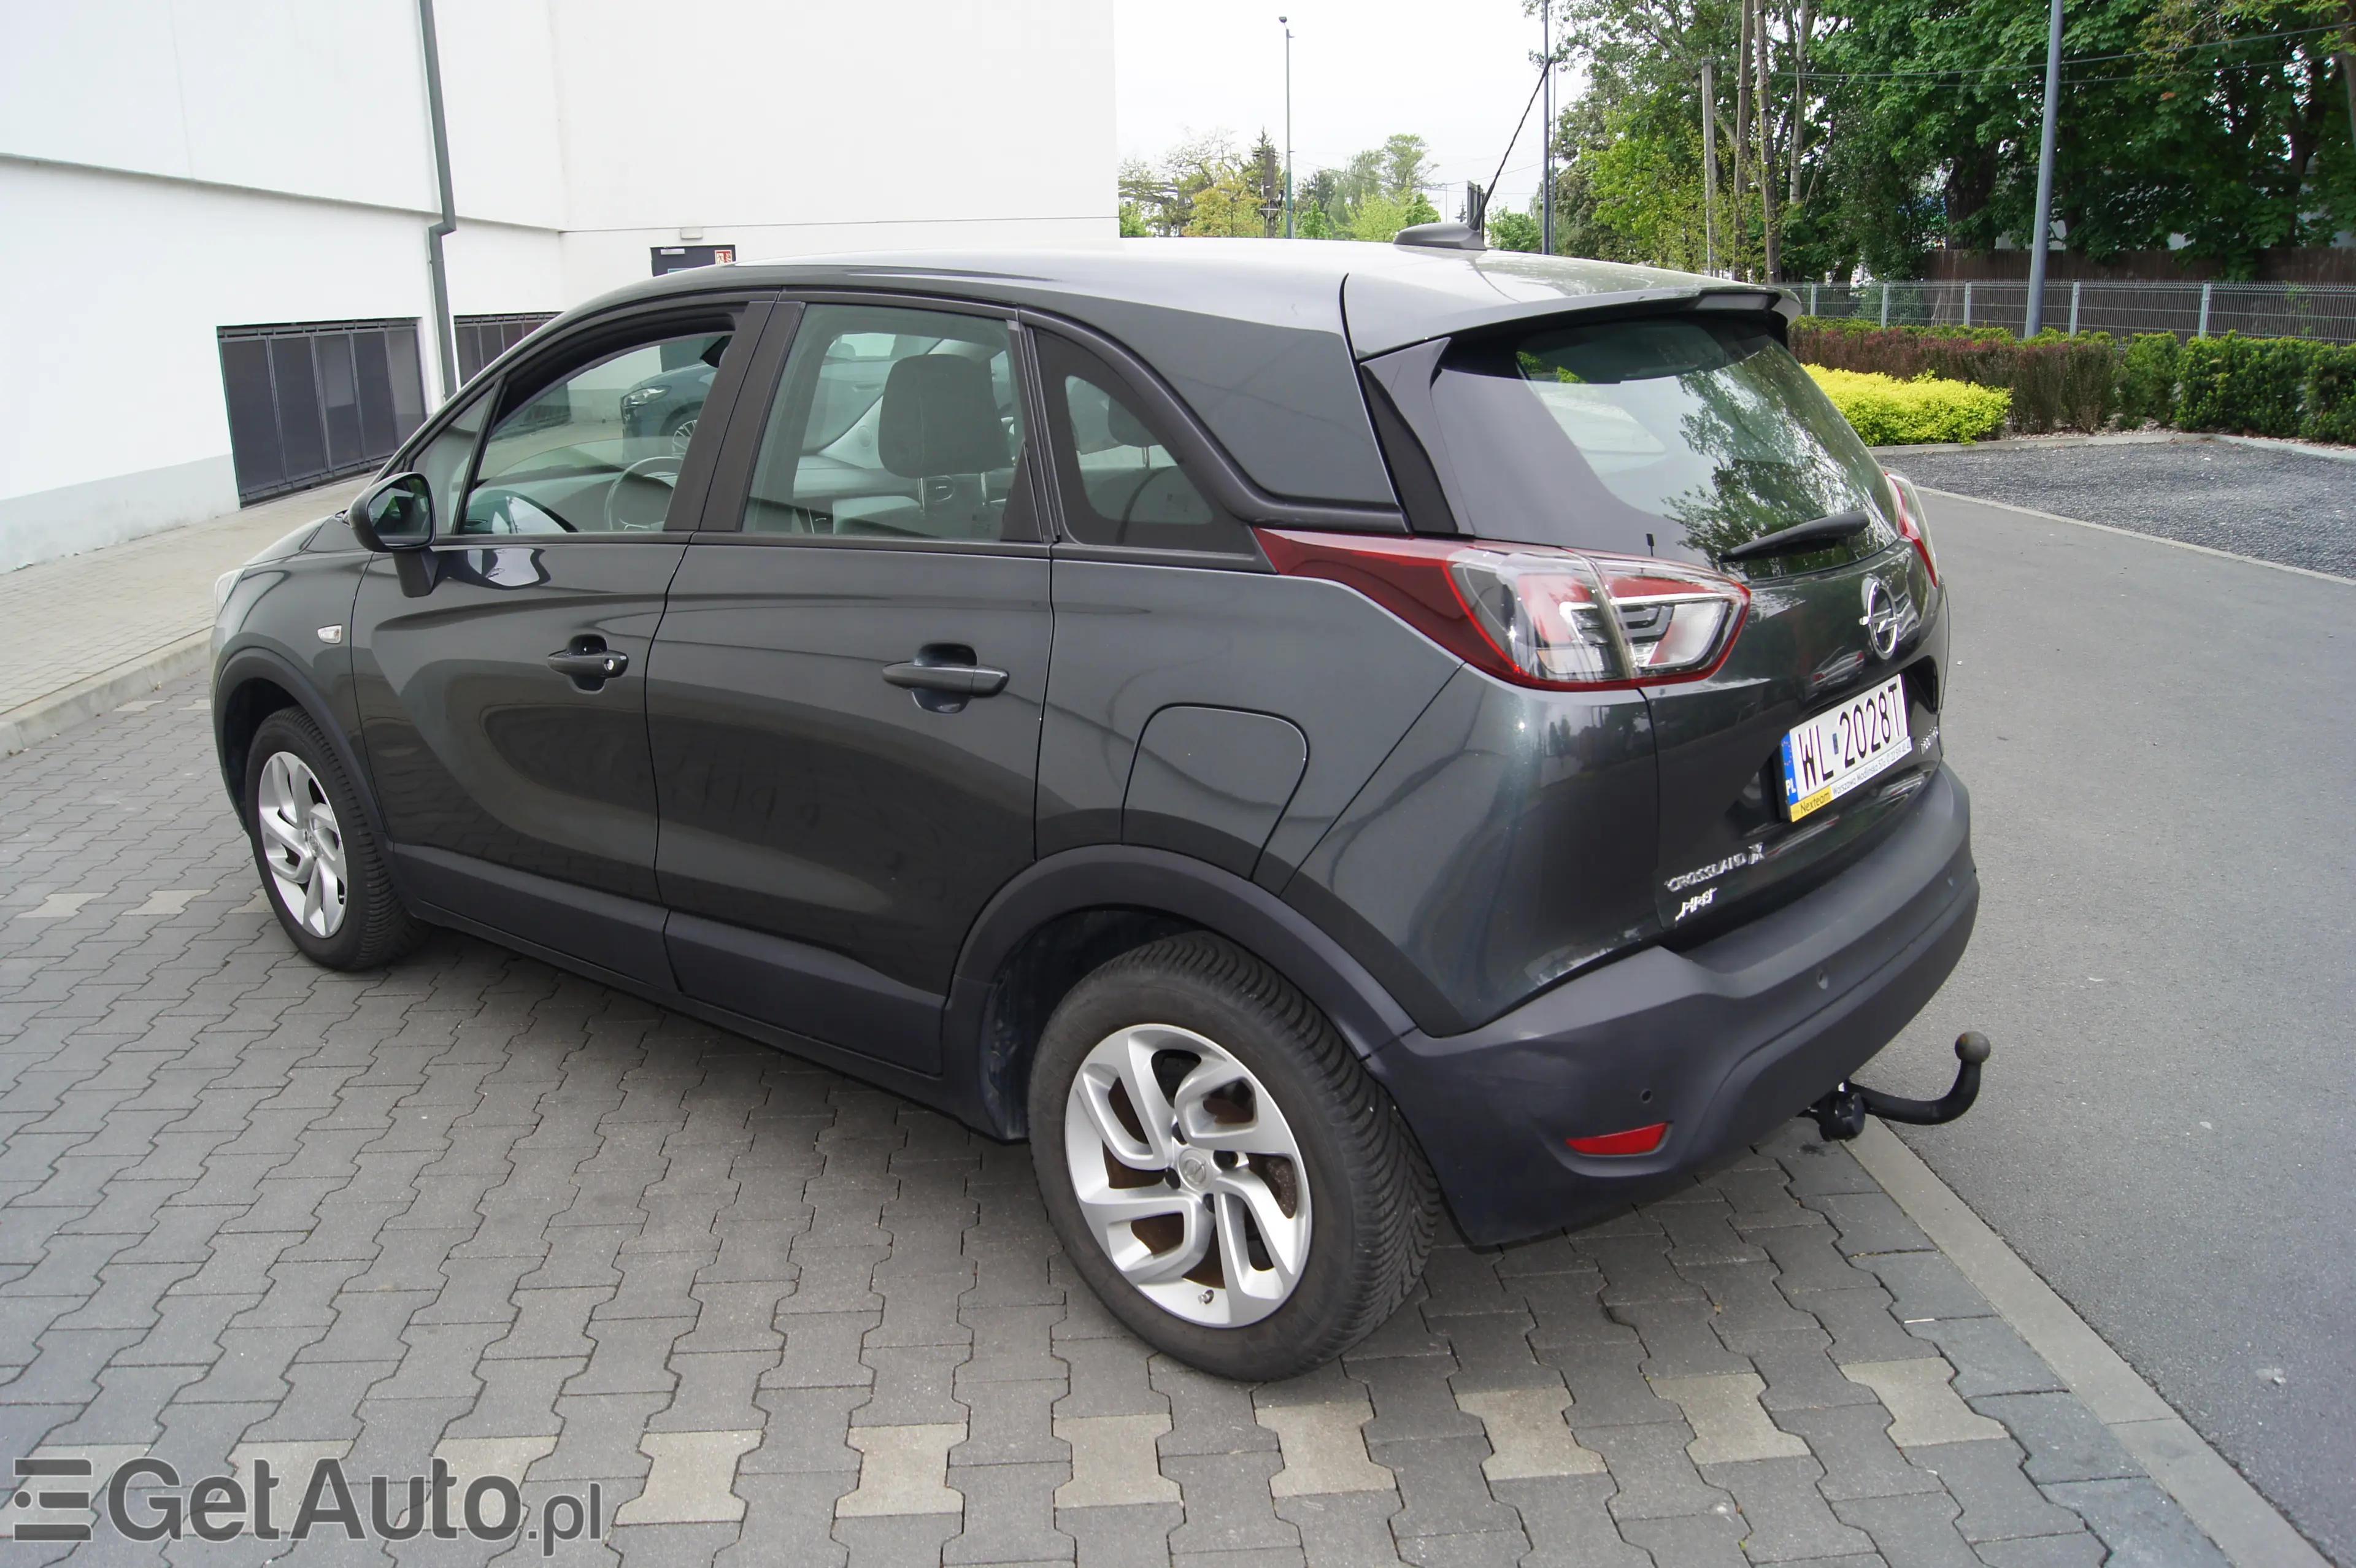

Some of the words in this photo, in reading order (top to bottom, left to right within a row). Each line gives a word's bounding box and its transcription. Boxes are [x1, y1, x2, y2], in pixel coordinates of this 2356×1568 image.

[1797, 725, 1834, 791] WL
[1839, 683, 1898, 769] 2028T
[1785, 778, 1797, 796] PL
[1800, 791, 1831, 815] Nexteam
[1665, 853, 1747, 892] CROSSLAND
[1749, 842, 1765, 864] X
